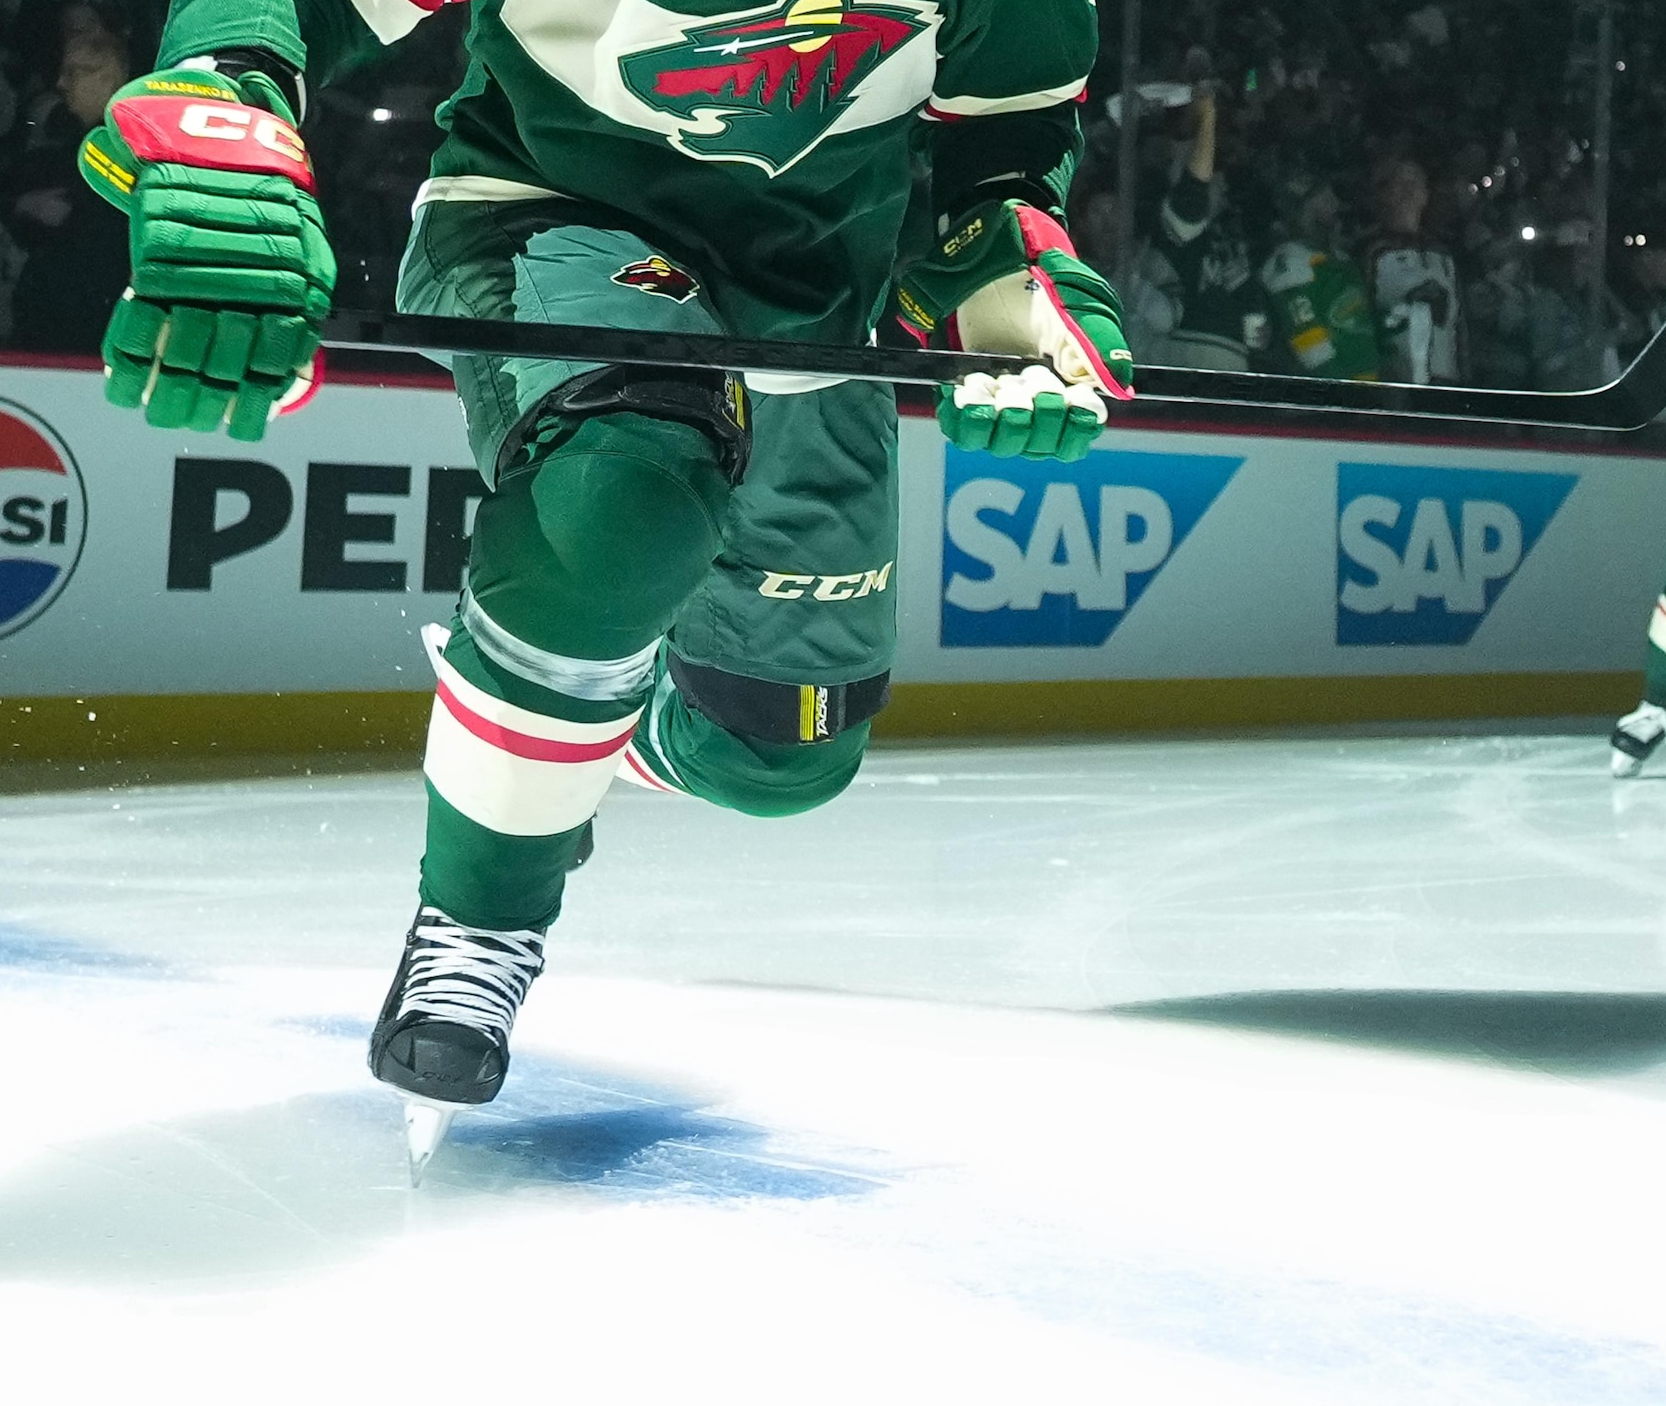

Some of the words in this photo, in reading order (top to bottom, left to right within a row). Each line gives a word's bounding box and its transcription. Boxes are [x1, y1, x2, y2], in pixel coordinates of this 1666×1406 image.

[179, 103, 310, 164] CC
[758, 560, 893, 602] CCM
[944, 477, 1175, 613] SAP
[1337, 497, 1525, 613] SAP
